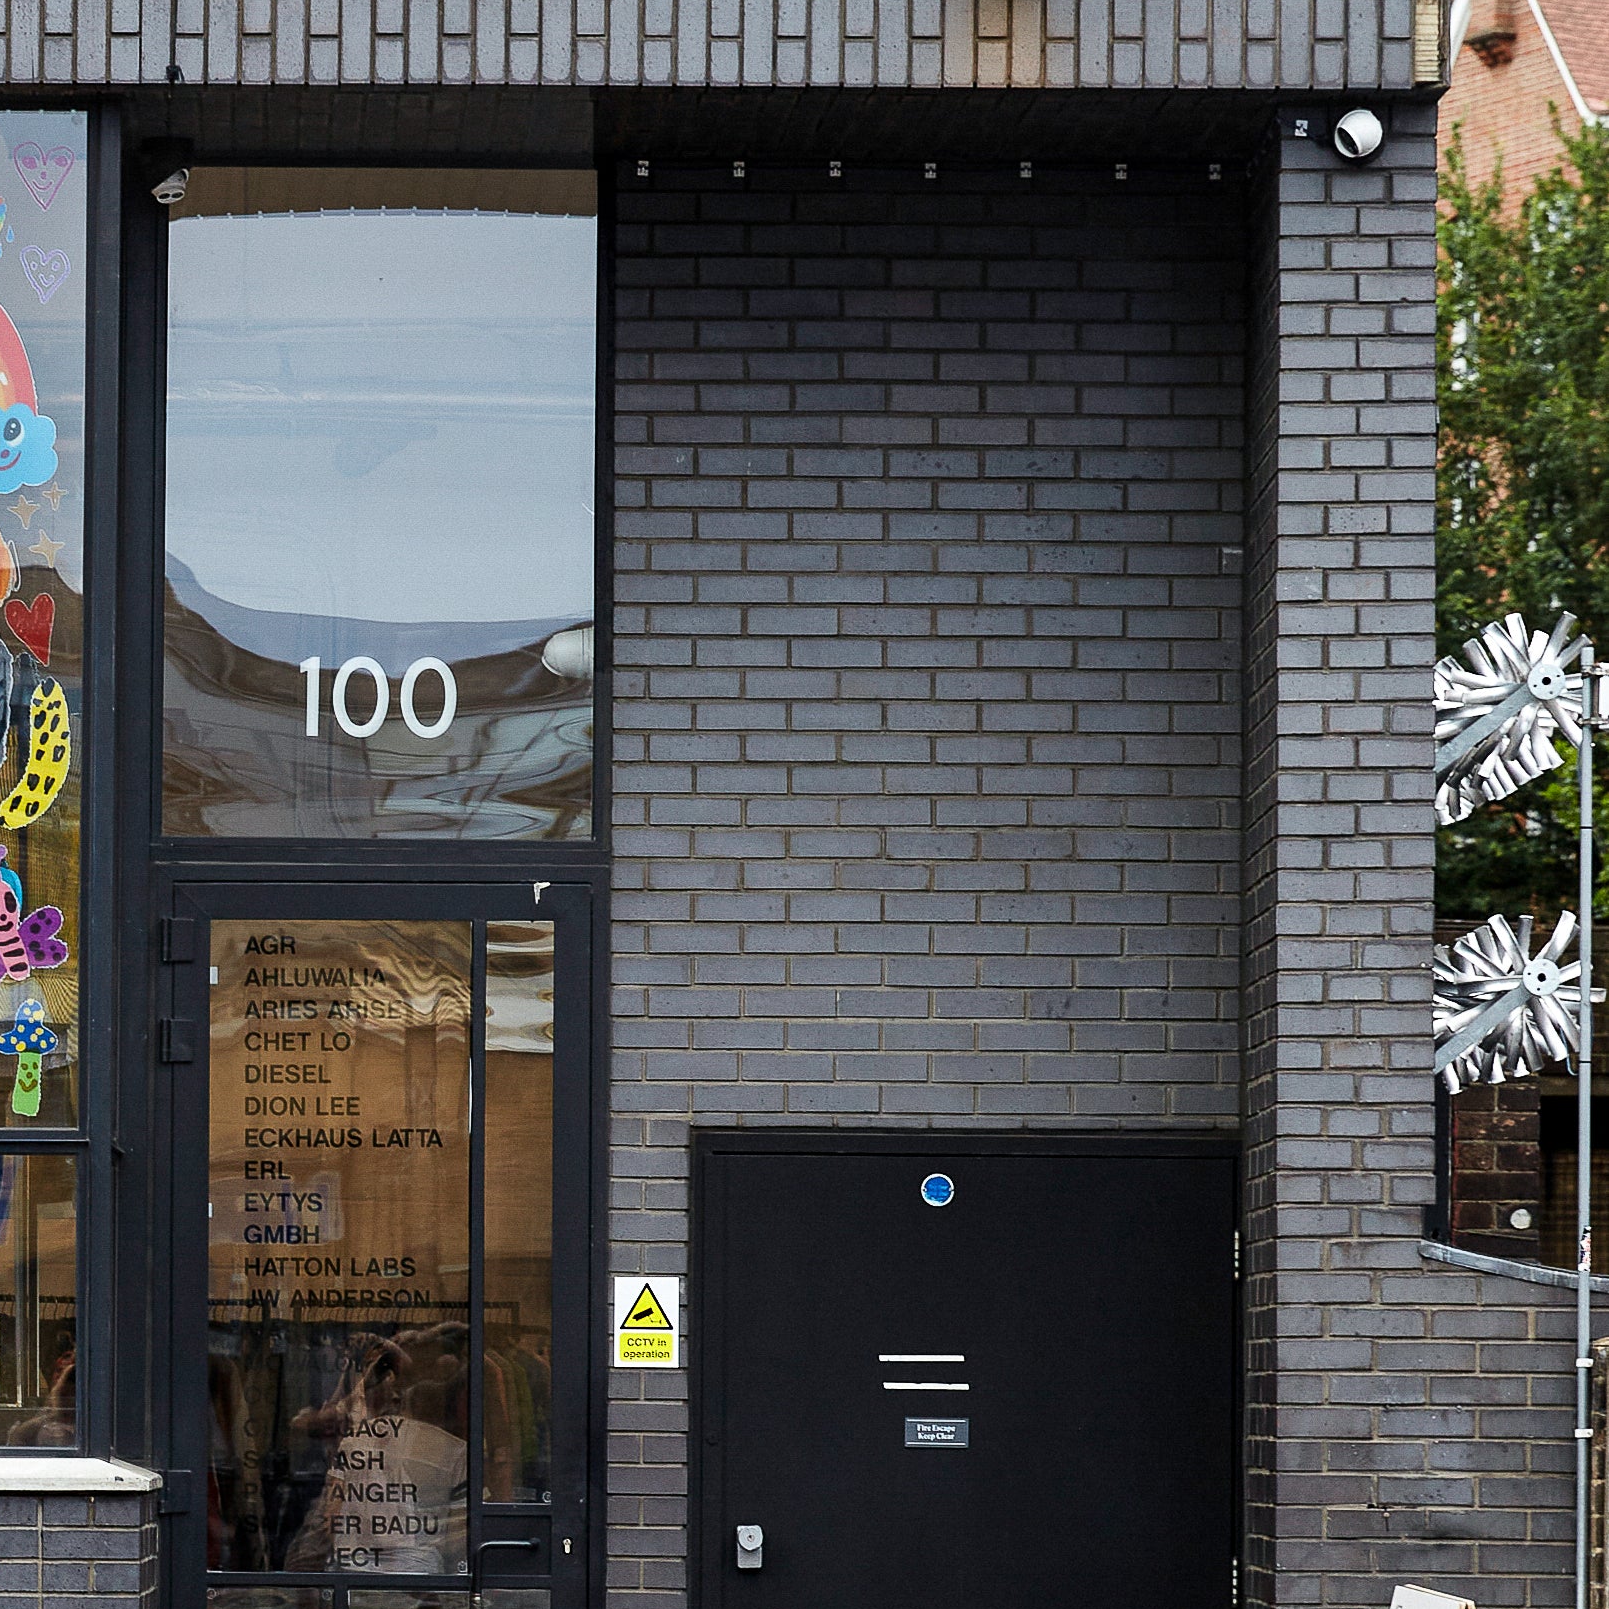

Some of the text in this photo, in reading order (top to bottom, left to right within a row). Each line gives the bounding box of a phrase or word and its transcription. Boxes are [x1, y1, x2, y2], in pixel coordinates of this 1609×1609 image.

[299, 656, 457, 739] 100
[244, 936, 296, 955] AGR
[244, 968, 386, 987] AHLUWALIA
[244, 1000, 402, 1019] ARIES ARISE
[244, 1032, 351, 1052] CHET LO
[245, 1064, 331, 1084] DIESEL
[245, 1096, 360, 1116] DION LEE
[245, 1128, 443, 1148] ECKHAUS LATTA
[244, 1160, 291, 1180] ERL
[245, 1192, 323, 1212] EYTYS
[244, 1224, 320, 1244] GMBH
[244, 1257, 416, 1277] HATTON LABS
[290, 1289, 430, 1308] ANDERSON
[626, 1337, 667, 1347] CCTV in
[623, 1349, 670, 1360] operation
[916, 1423, 956, 1433] Fire Escape
[917, 1432, 955, 1441] Keep Clear
[371, 1515, 439, 1536] BADU
